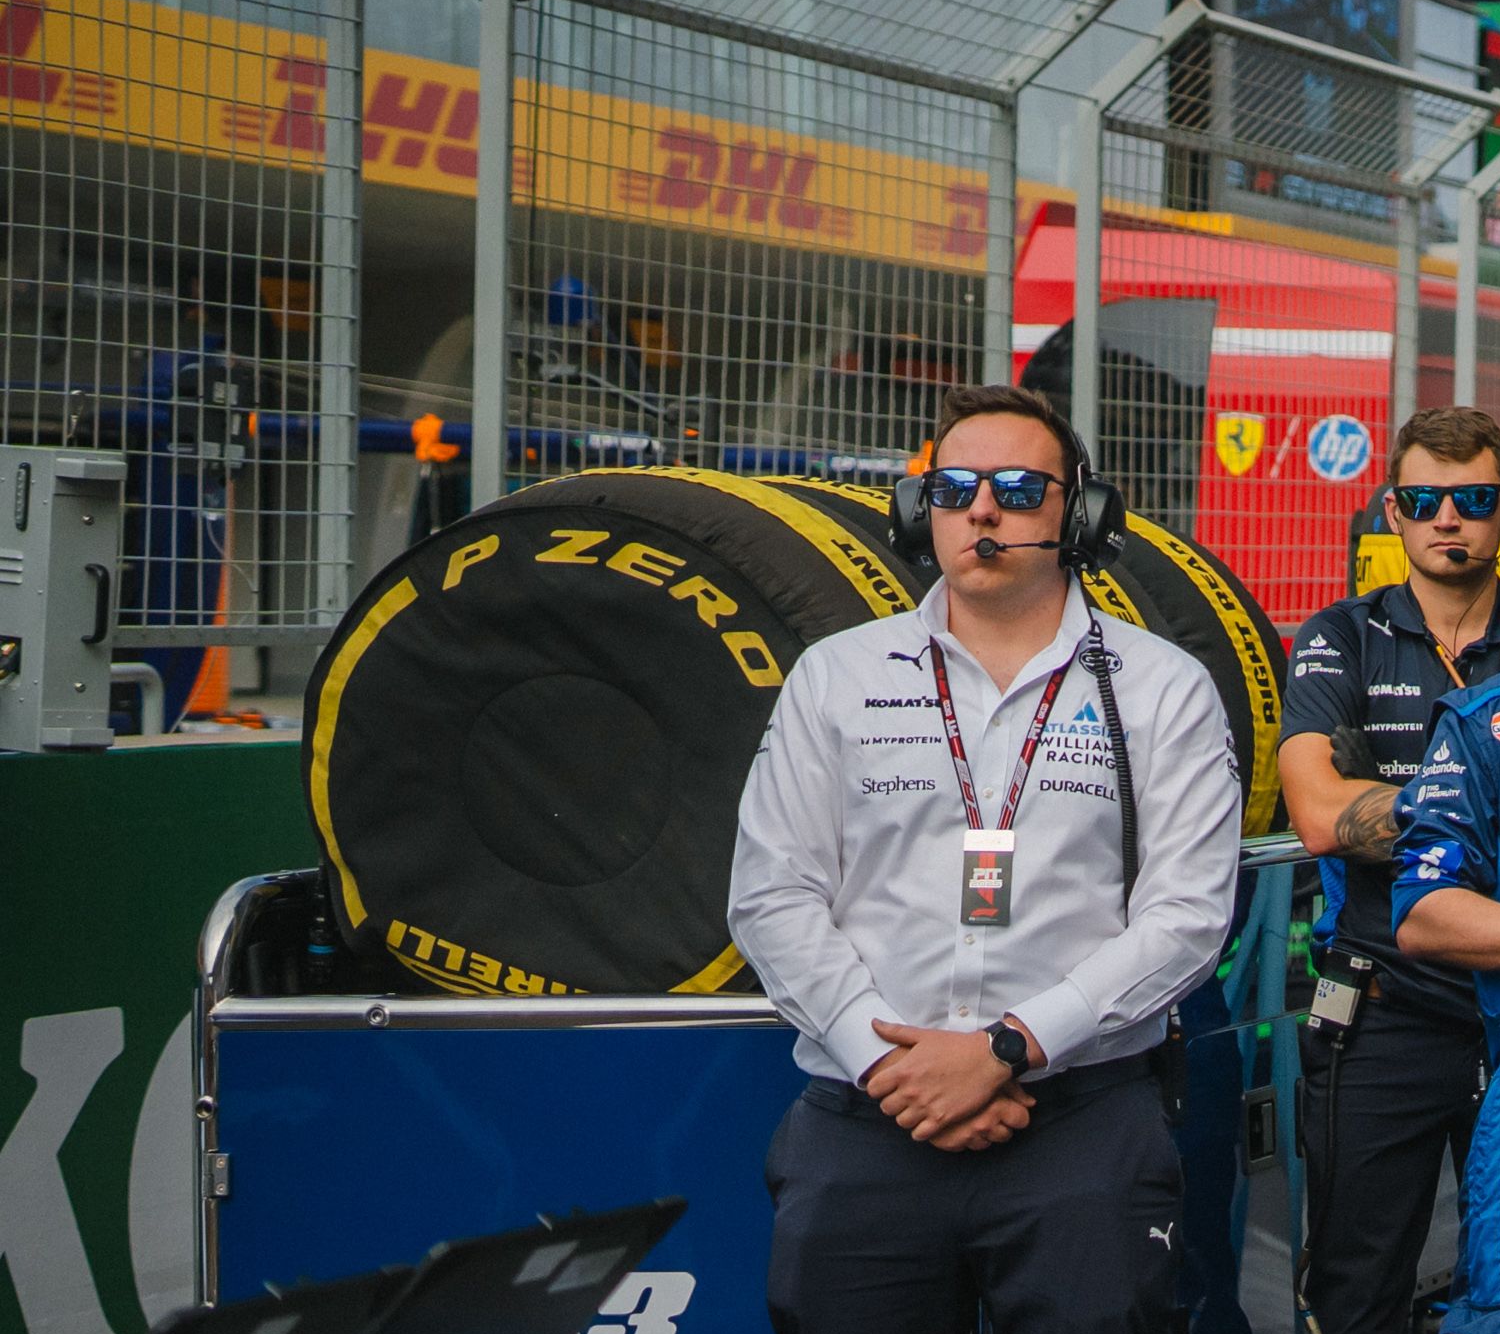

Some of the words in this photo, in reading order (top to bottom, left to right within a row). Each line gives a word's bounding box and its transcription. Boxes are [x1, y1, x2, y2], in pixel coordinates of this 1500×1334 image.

[656, 128, 822, 229] DHL
[442, 534, 499, 591] P
[534, 529, 784, 688] ZERO
[1241, 622, 1276, 724] RIGHT
[873, 736, 942, 745] MYPROTEIN
[1039, 737, 1114, 753] WILLIAM
[1046, 750, 1116, 769] RACING
[862, 776, 936, 795] Stephens
[1040, 779, 1117, 802] DURACELL
